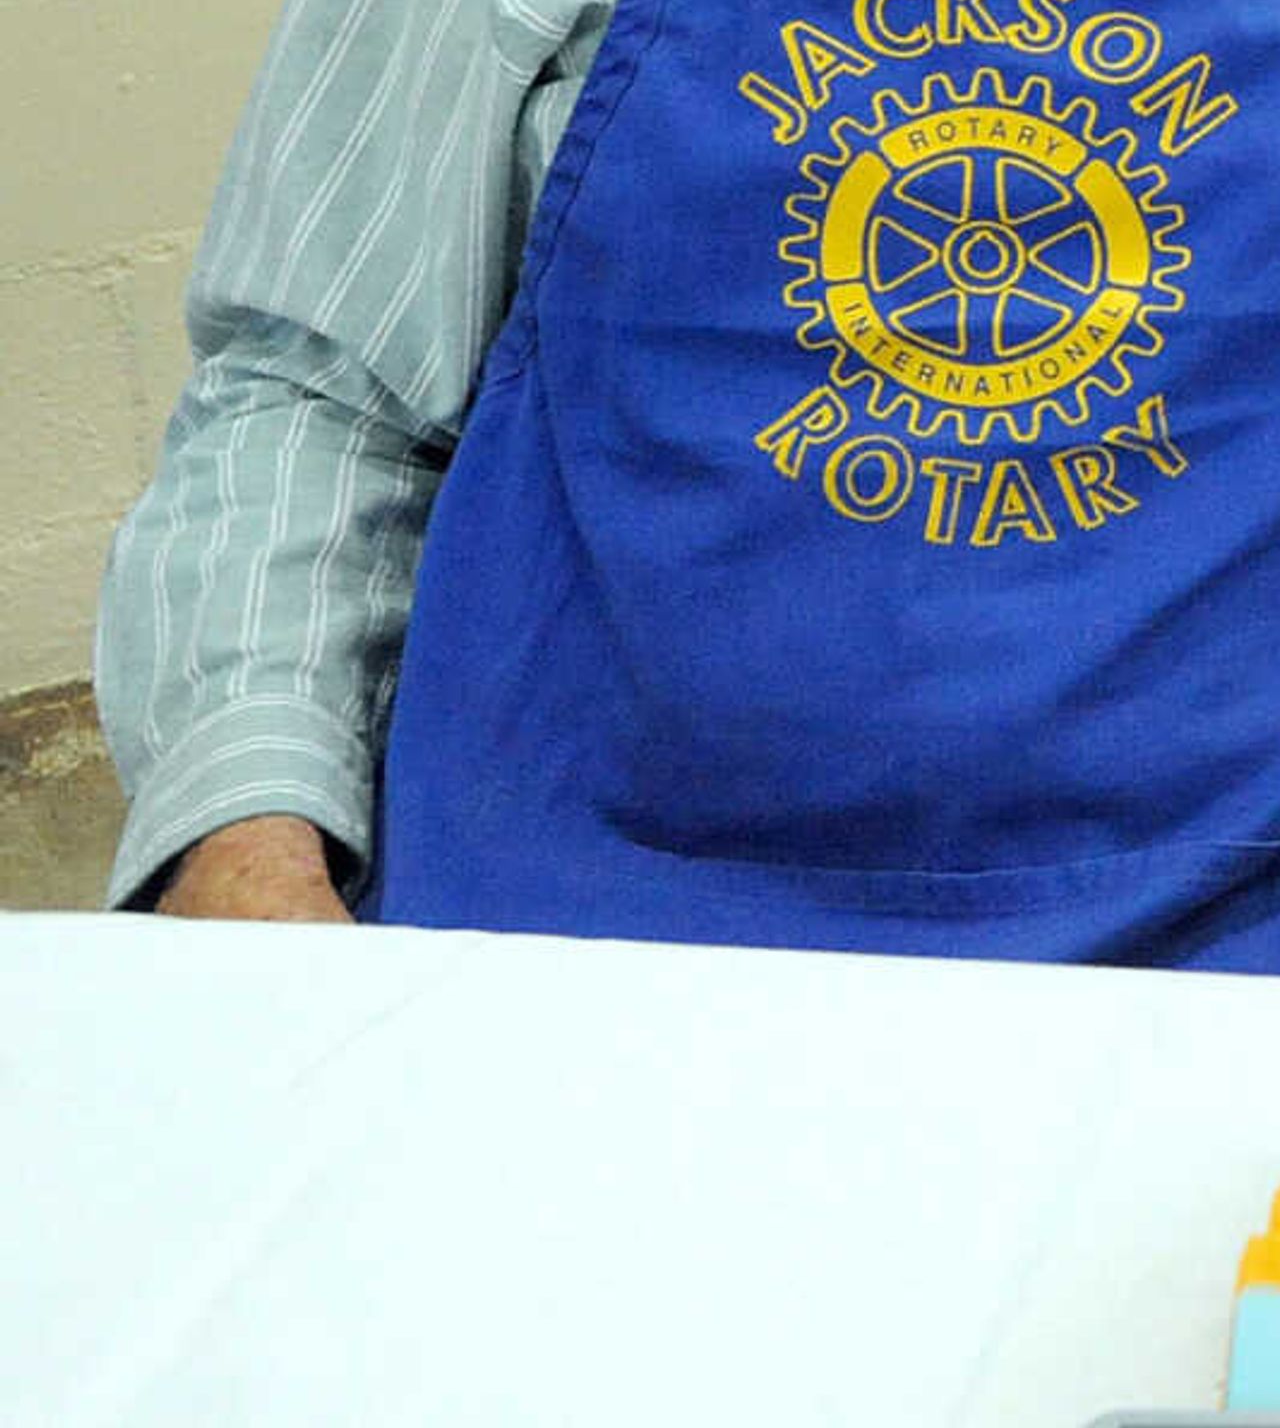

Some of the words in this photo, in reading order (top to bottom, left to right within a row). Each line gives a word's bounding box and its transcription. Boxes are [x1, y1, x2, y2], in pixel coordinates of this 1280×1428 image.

[907, 116, 1066, 159] ROTARY
[841, 300, 1129, 398] INTERNATIONAL
[753, 385, 1190, 548] ROTARY
